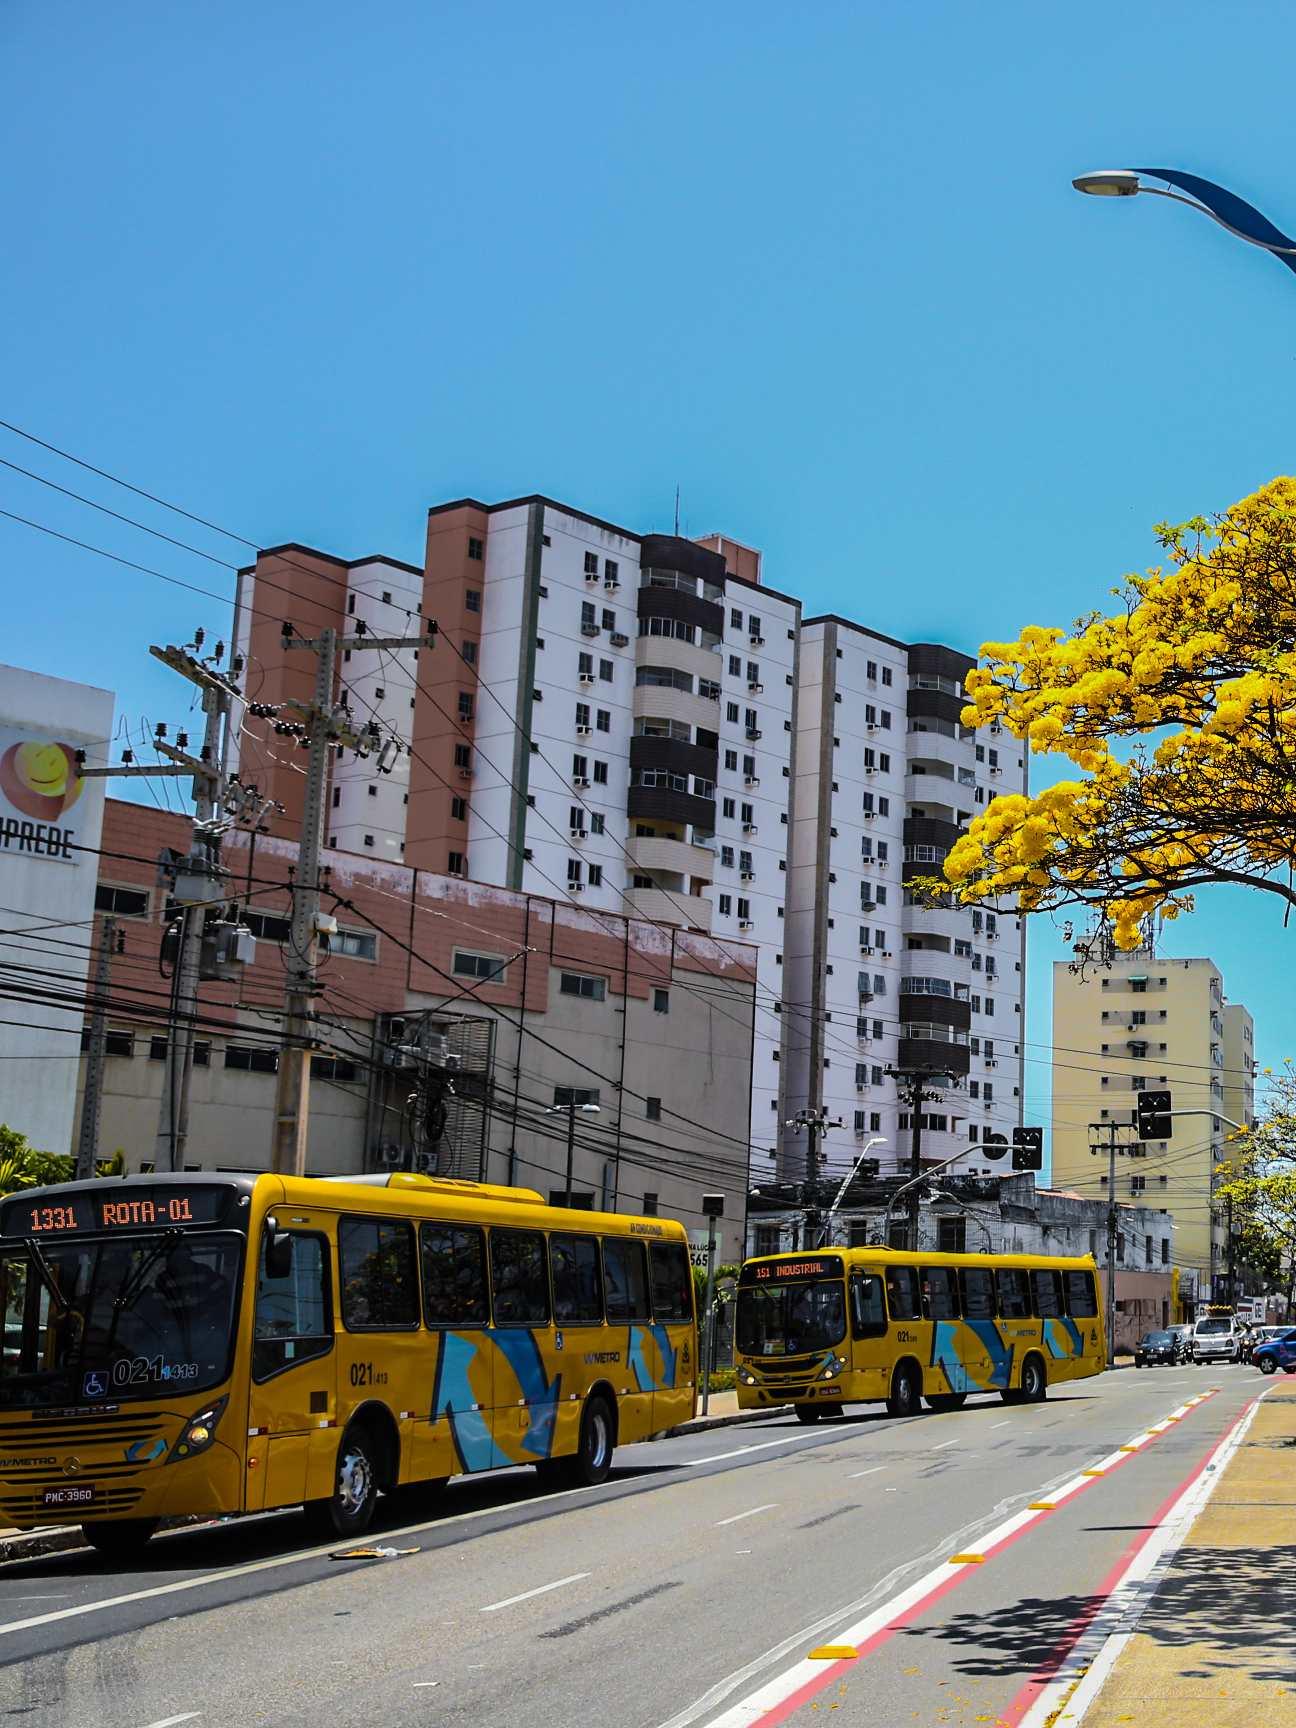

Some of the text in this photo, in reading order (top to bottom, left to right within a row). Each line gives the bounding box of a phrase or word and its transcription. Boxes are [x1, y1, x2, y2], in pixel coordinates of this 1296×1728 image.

[0, 817, 74, 859] PREDE
[30, 1198, 193, 1231] 1331 ROTA-01
[756, 1263, 824, 1279] 151 INDUSTRIAL
[350, 1362, 373, 1387] 021
